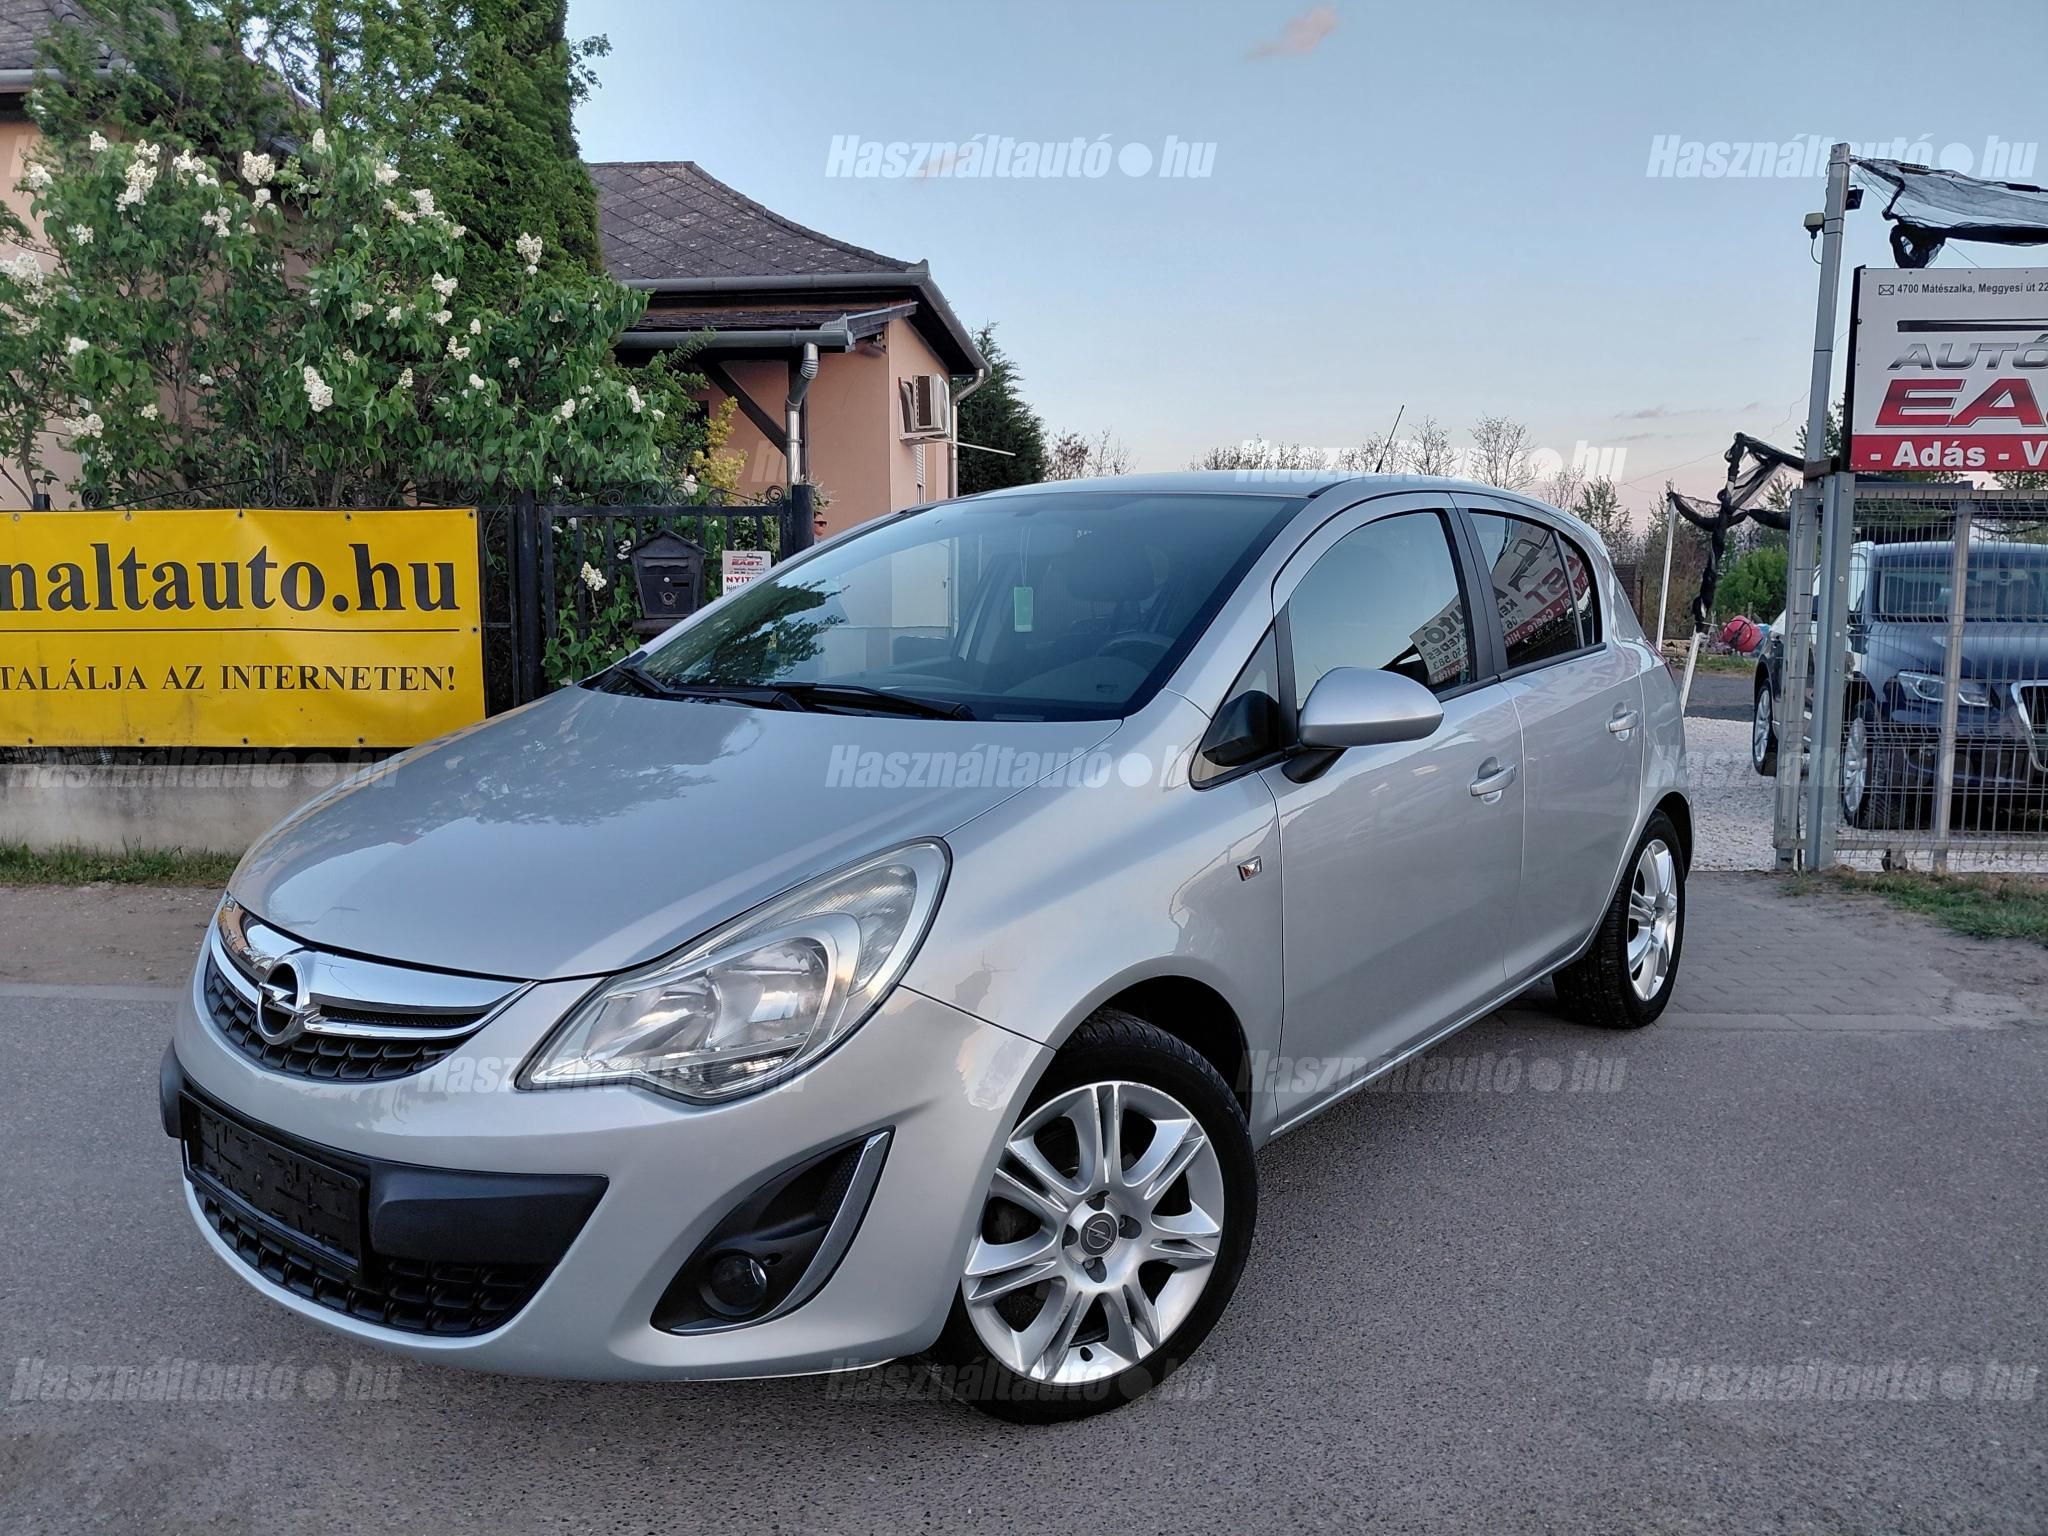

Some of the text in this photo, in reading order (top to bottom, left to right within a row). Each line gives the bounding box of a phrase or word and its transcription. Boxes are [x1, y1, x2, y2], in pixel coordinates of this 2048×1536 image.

[1896, 283, 1919, 294] 4700
[1978, 283, 2024, 295] Meggyesi
[1875, 378, 2048, 429] EA
[1892, 440, 1986, 467] Adás
[0, 658, 455, 691] TALÁLJA AZ INTERNETEN!
